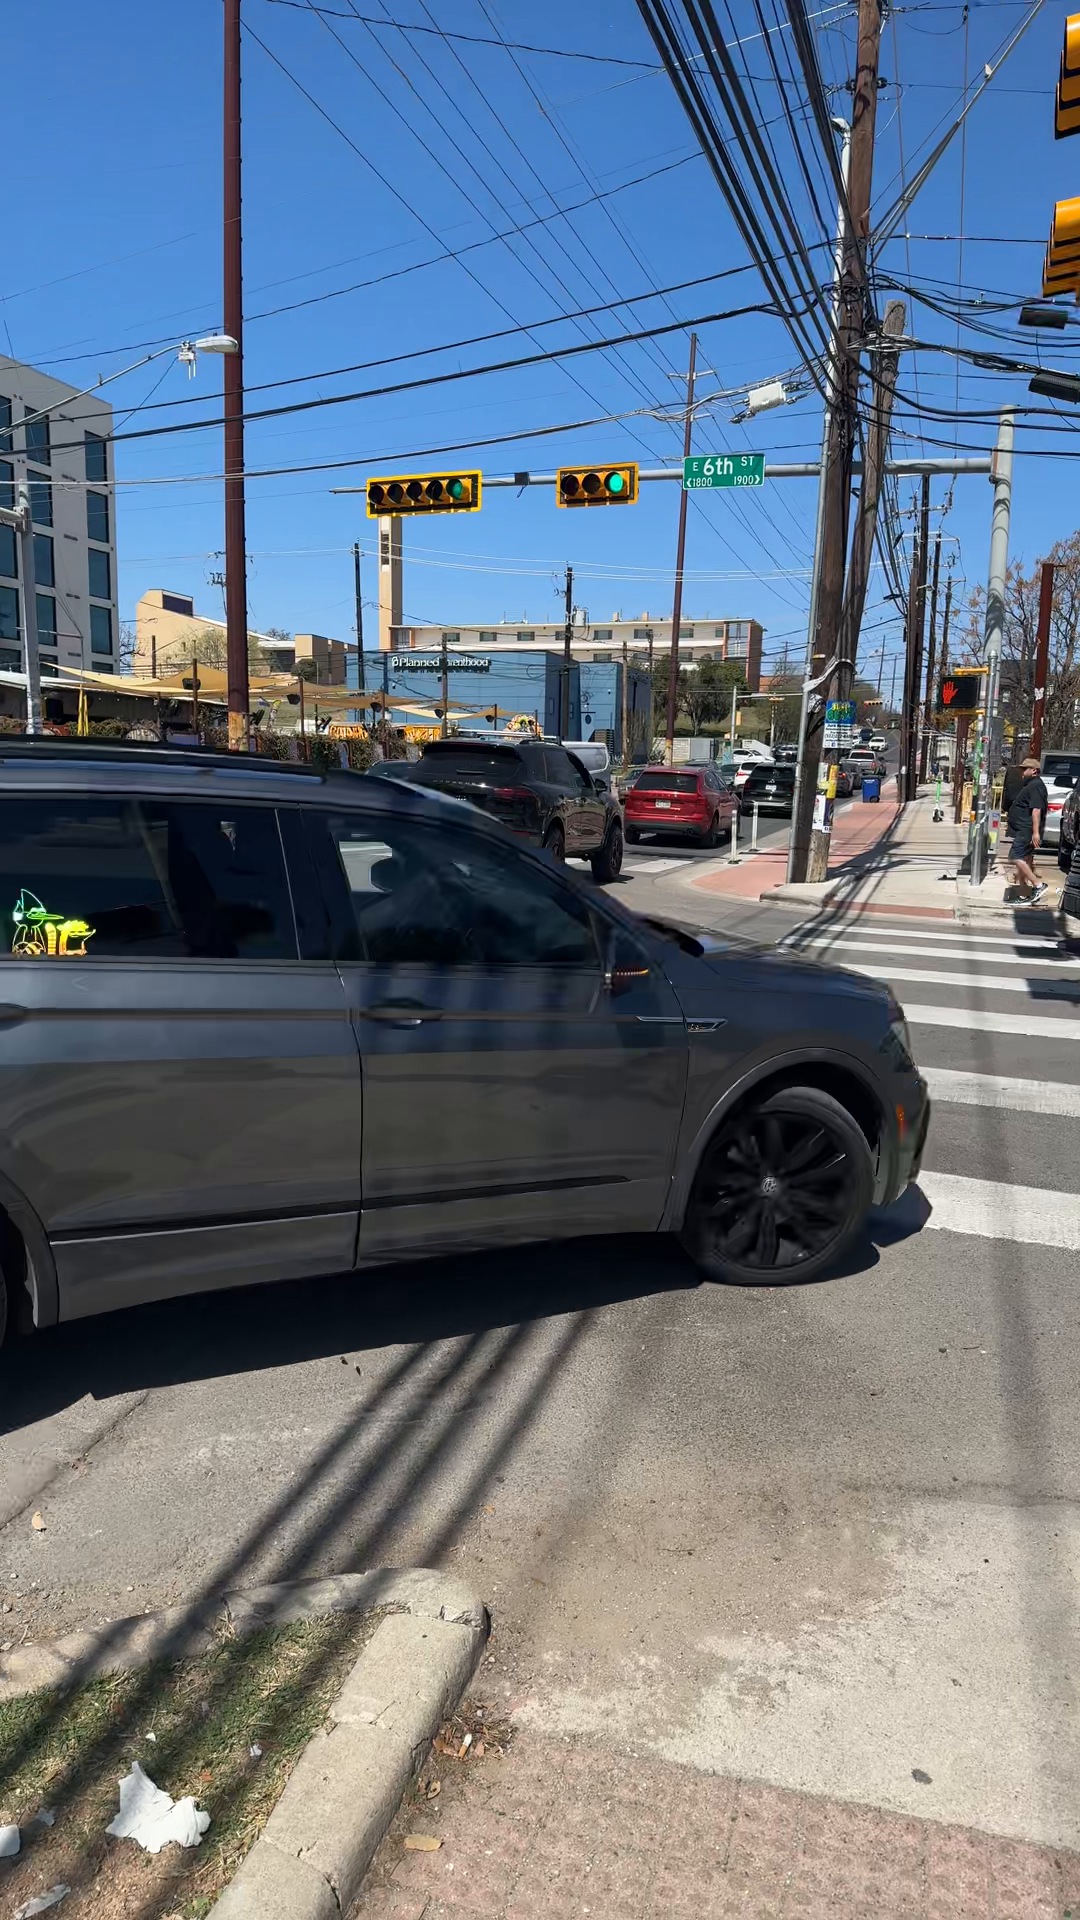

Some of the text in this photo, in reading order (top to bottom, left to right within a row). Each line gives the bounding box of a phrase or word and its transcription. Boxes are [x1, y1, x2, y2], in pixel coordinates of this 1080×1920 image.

[693, 456, 755, 476] E 6th ST
[693, 475, 754, 487] 1800 1900
[399, 656, 490, 667] Planned renthood
